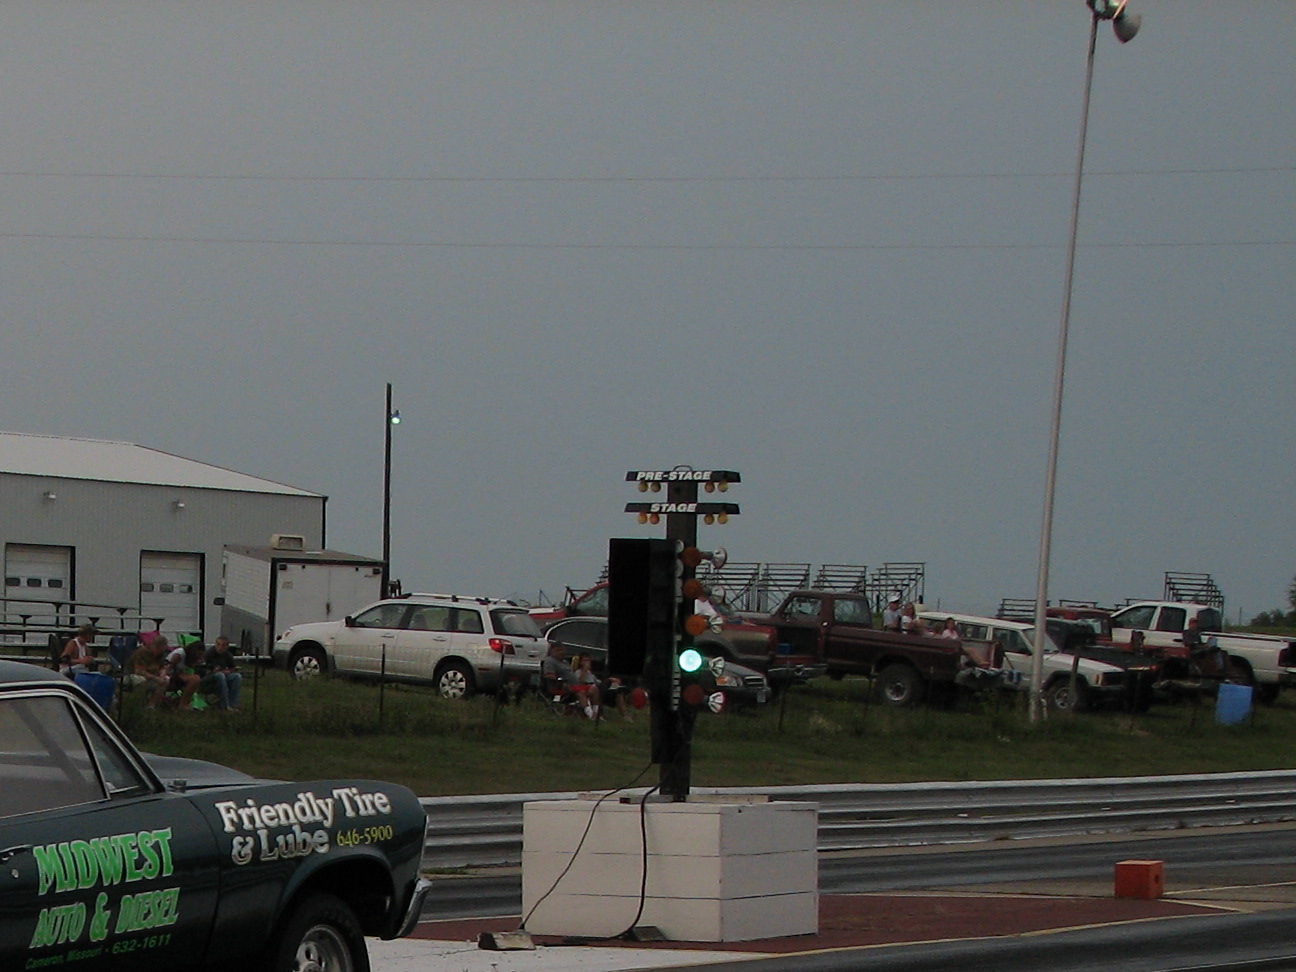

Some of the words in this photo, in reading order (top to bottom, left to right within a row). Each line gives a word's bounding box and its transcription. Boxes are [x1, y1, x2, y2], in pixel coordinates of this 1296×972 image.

[636, 471, 712, 481] PRE-STAGE
[650, 503, 697, 513] STAGE
[215, 792, 334, 833] Friendly
[331, 786, 392, 818] Tire
[231, 835, 255, 865] &
[257, 824, 330, 861] Lube
[337, 825, 393, 847] 646-5900
[33, 827, 174, 896] MIDWEST
[29, 901, 87, 949] AUTO
[89, 892, 111, 942] &
[115, 887, 180, 934] DIESEL
[112, 934, 172, 954] 632-1611
